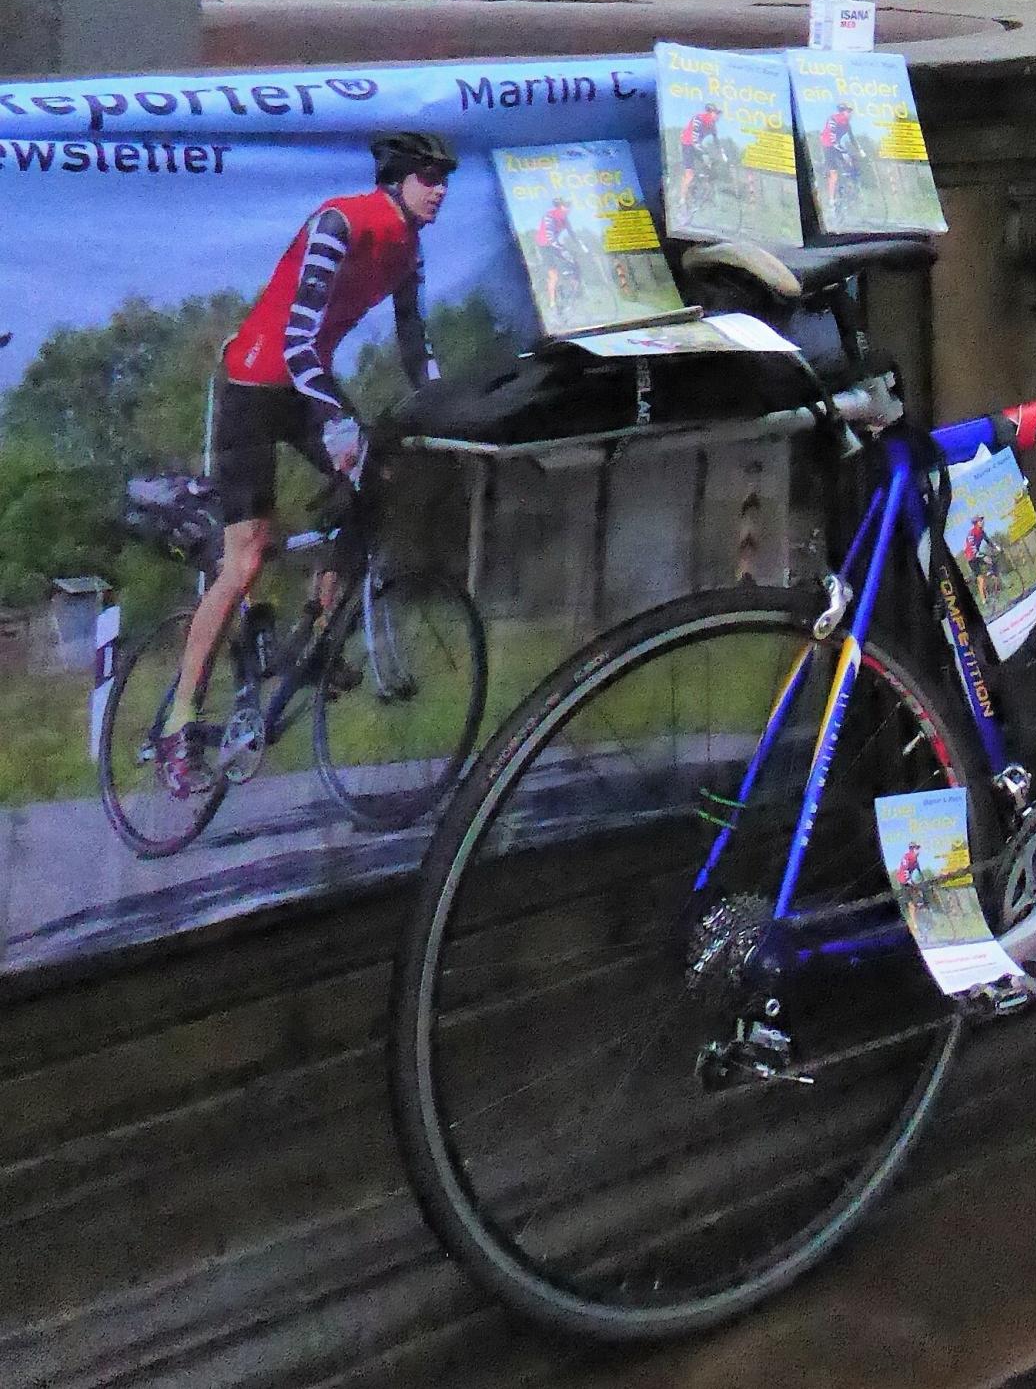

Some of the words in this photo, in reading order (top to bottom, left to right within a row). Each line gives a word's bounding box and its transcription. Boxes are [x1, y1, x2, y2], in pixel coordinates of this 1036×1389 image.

[840, 9, 869, 21] ISANA
[456, 75, 597, 111] Martin
[669, 82, 704, 102] ein
[708, 75, 778, 106] Räder
[836, 76, 899, 98] Räder
[721, 99, 783, 130] Land
